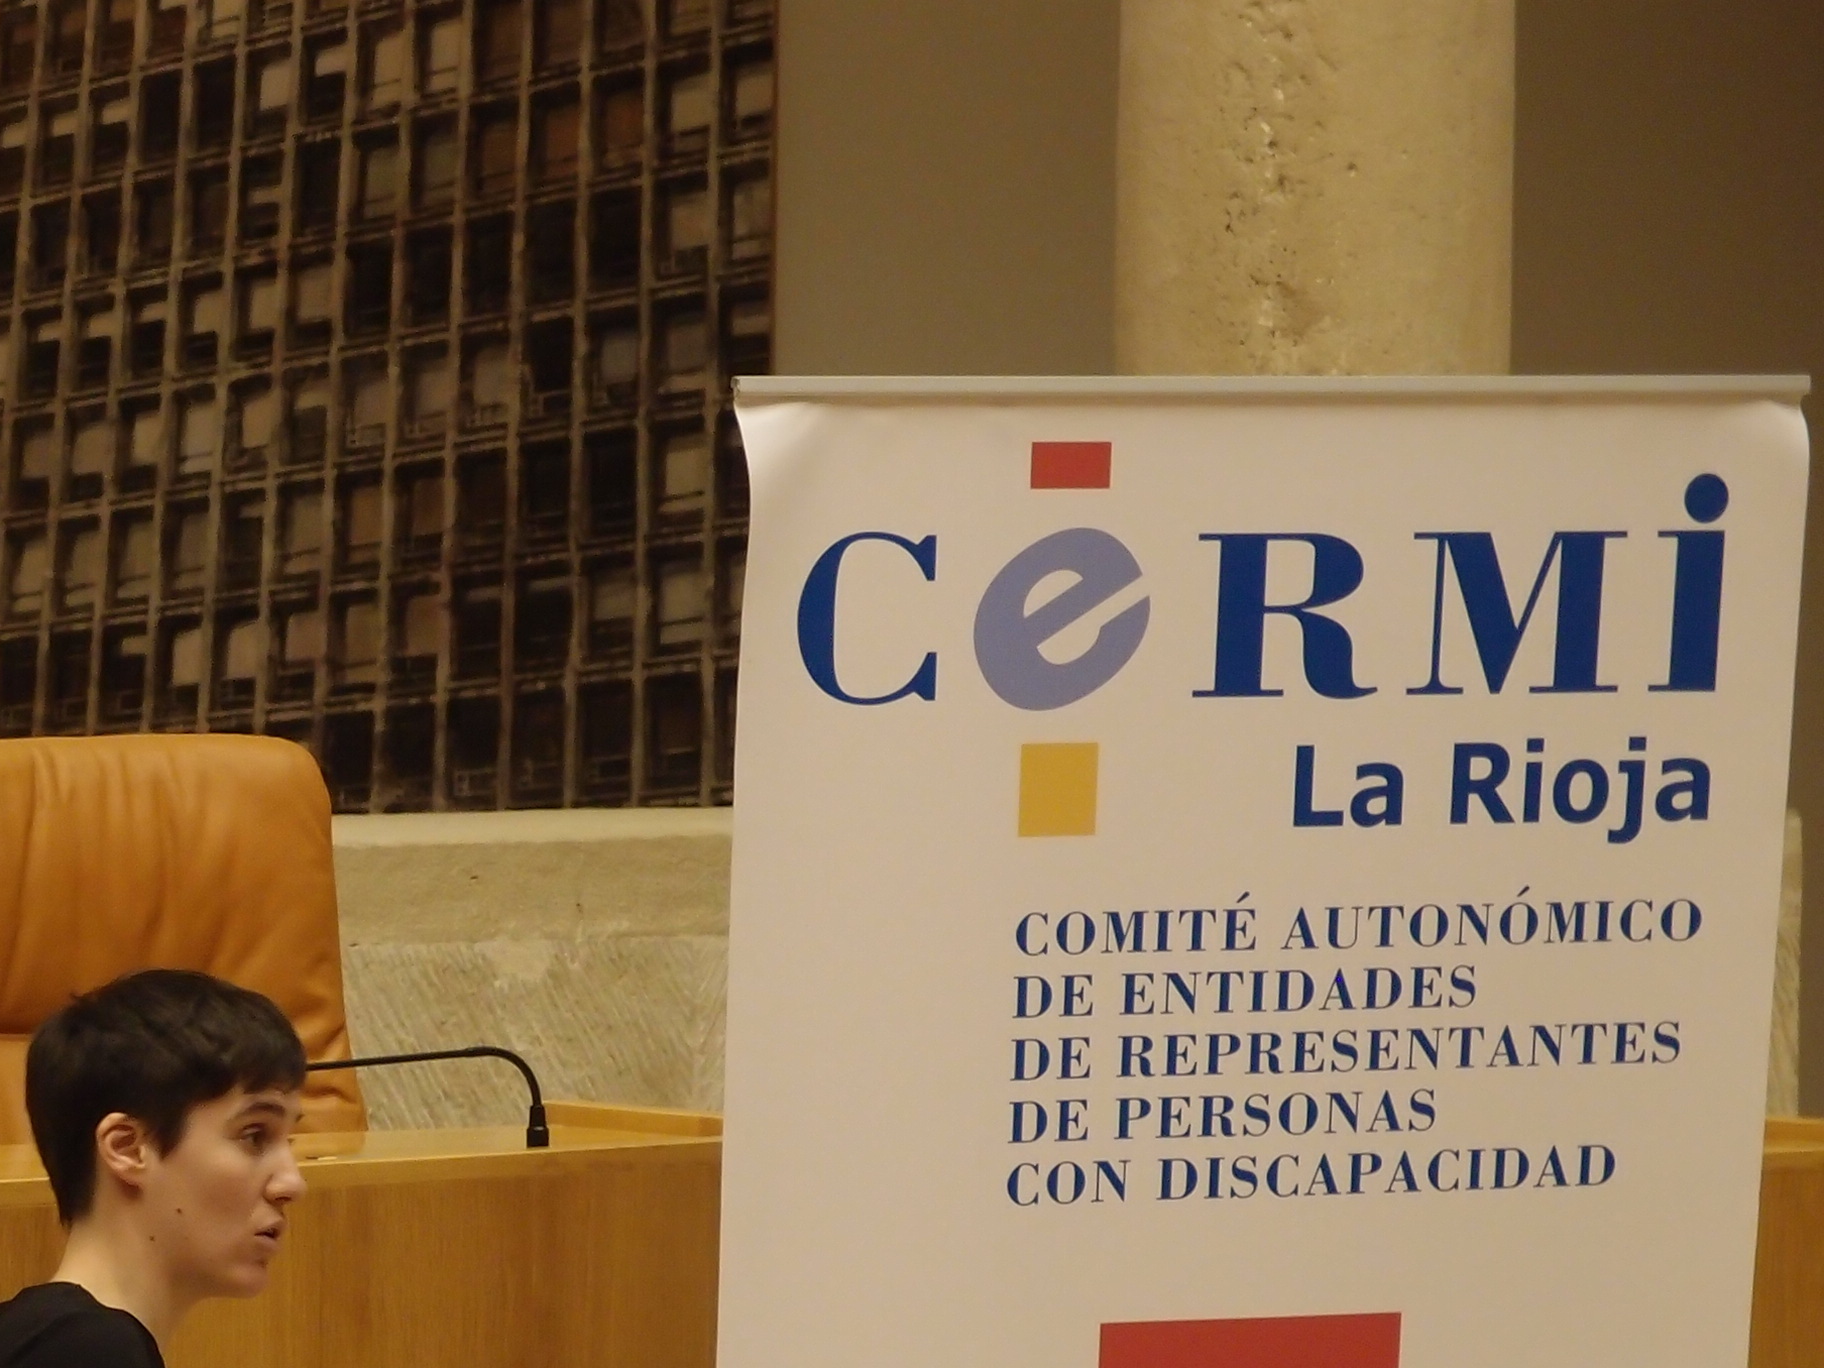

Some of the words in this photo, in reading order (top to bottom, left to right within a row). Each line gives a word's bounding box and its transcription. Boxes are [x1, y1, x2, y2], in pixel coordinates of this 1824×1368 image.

[1291, 743, 1406, 830] La
[1448, 735, 1712, 845] Rioja
[1014, 892, 1257, 955] COMITÉ
[1281, 886, 1704, 951] AUTONÓMICO
[1013, 973, 1095, 1020] DE
[1120, 965, 1479, 1018] ENTIDADES
[1010, 1035, 1093, 1083] DE
[1117, 1021, 1683, 1079] REPRESENTANTES
[1008, 1098, 1091, 1145] DE
[1113, 1090, 1439, 1142] PERSONAS
[1003, 1158, 1129, 1206] CON
[1157, 1144, 1619, 1202] DISCAPACIDAD
